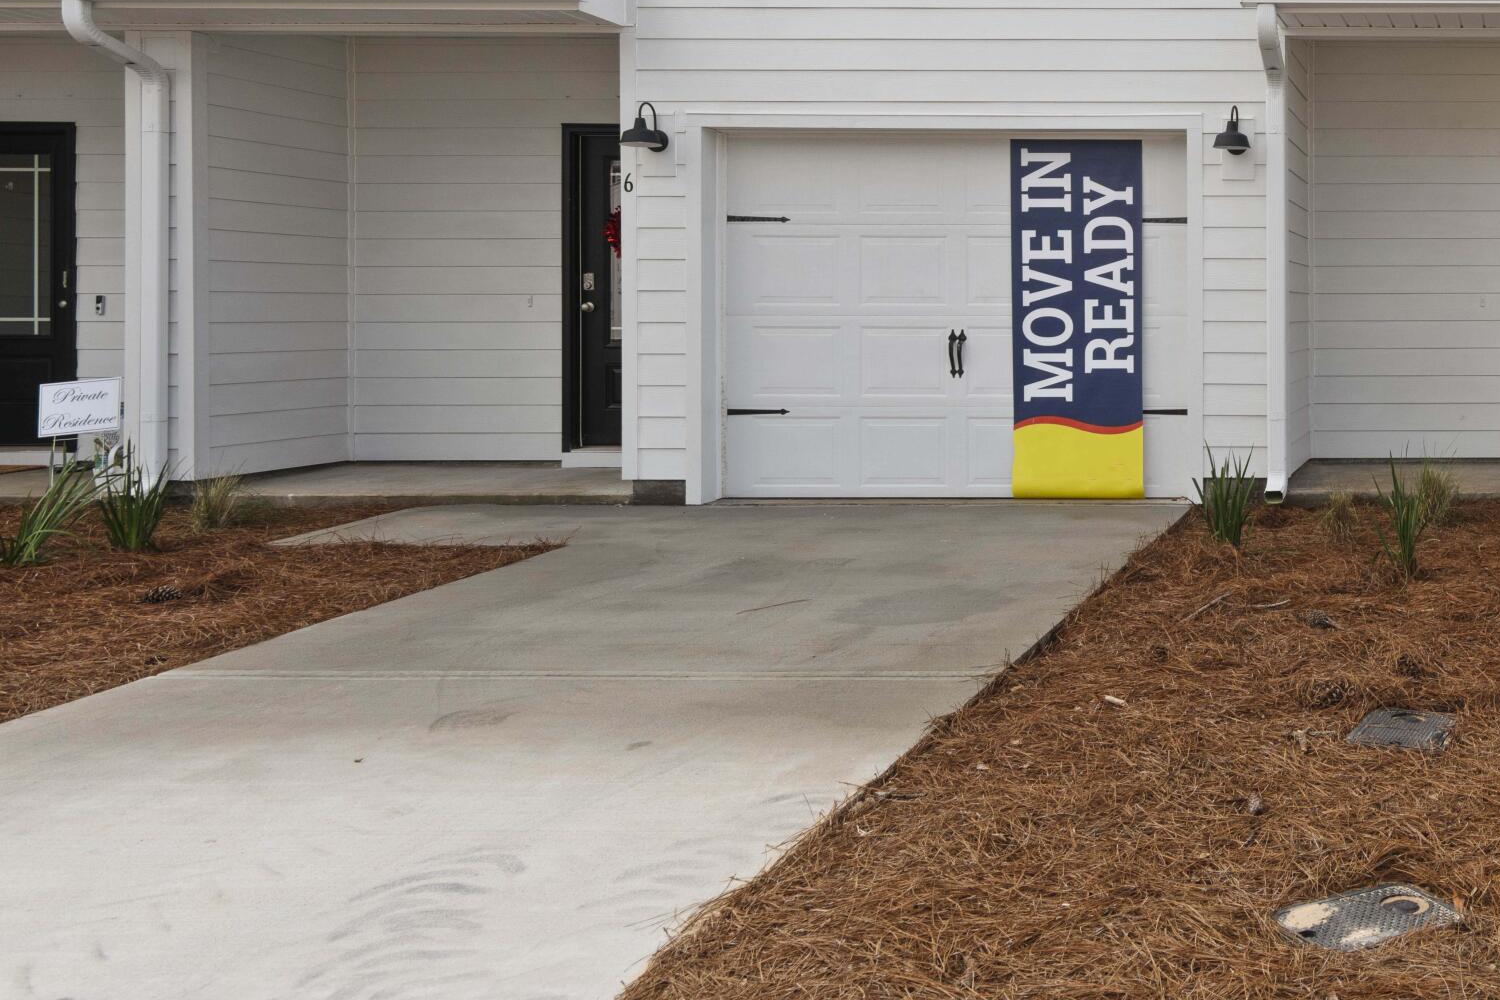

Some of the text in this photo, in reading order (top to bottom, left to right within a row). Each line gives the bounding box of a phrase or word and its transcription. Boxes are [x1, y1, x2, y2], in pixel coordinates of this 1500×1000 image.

[624, 172, 634, 193] 6
[1021, 148, 1073, 401] MOVE IN
[1083, 176, 1134, 373] READY
[52, 387, 108, 404] Private
[41, 413, 117, 430] Residence
